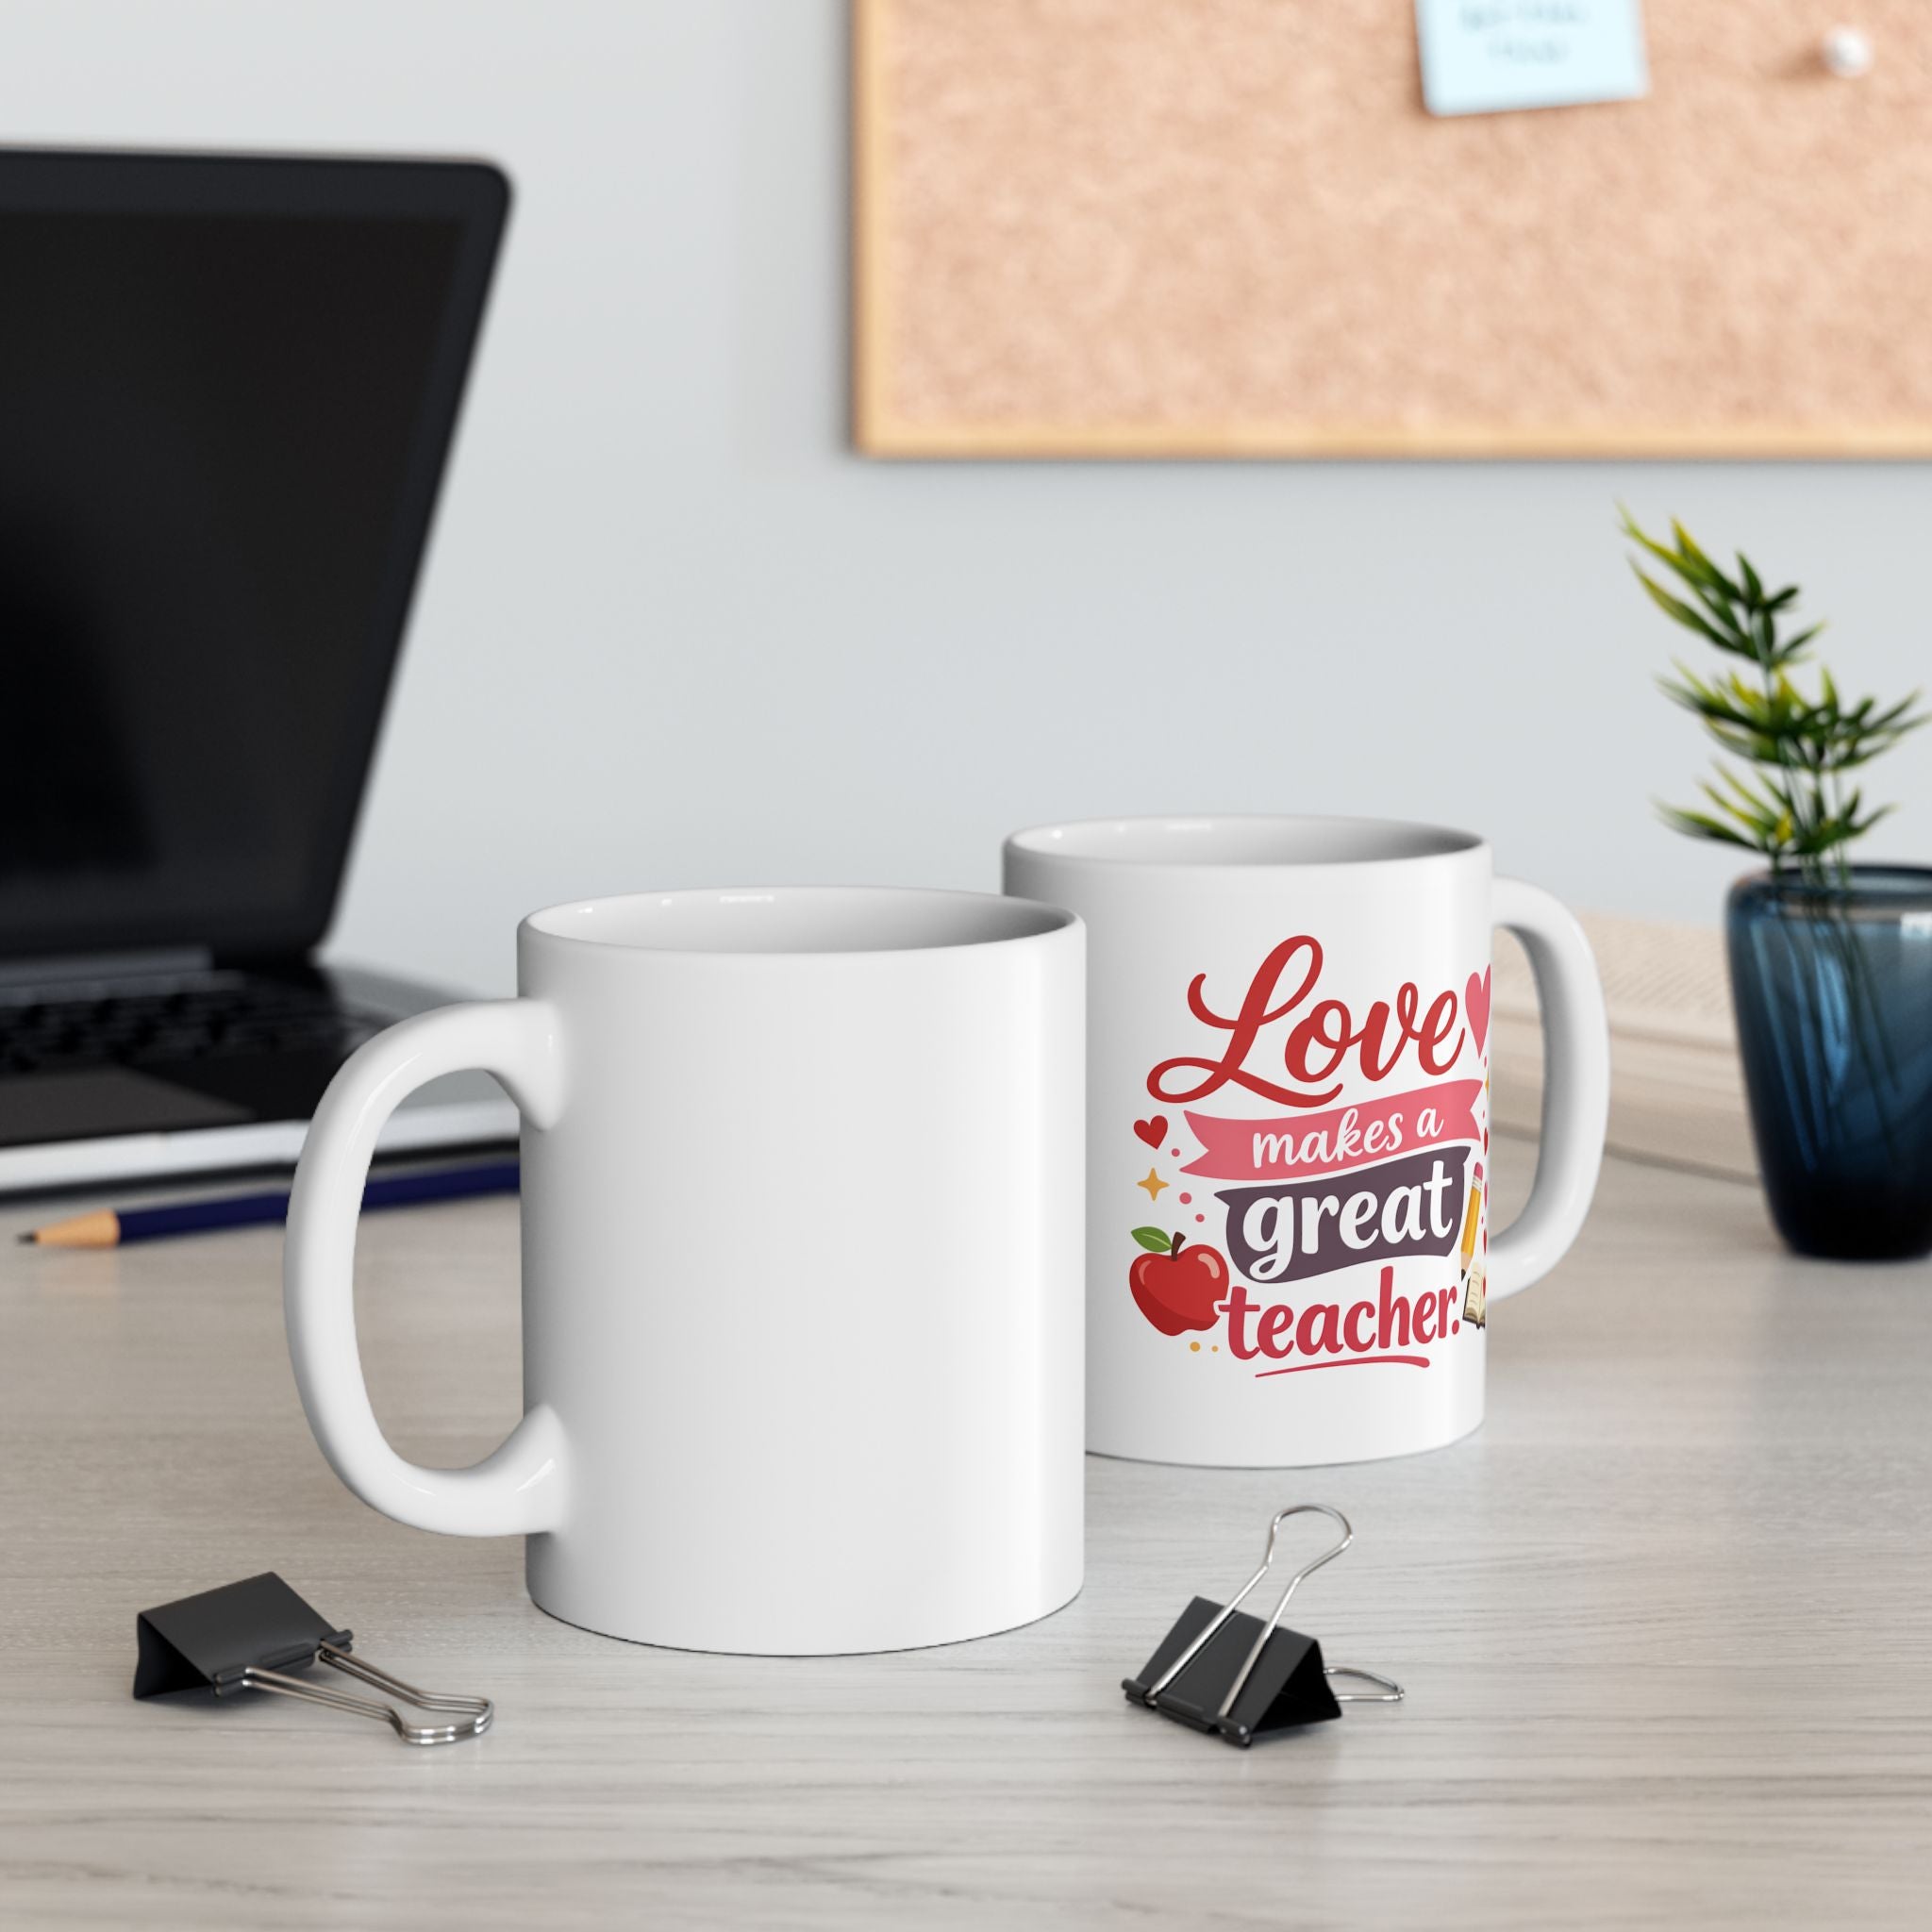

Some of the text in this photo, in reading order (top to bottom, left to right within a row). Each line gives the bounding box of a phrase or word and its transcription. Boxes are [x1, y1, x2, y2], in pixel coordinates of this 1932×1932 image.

[1146, 935, 1465, 1108] Love
[1253, 1108, 1444, 1169] makes a
[1242, 1159, 1454, 1281] great
[1218, 1265, 1460, 1360] teacher.
